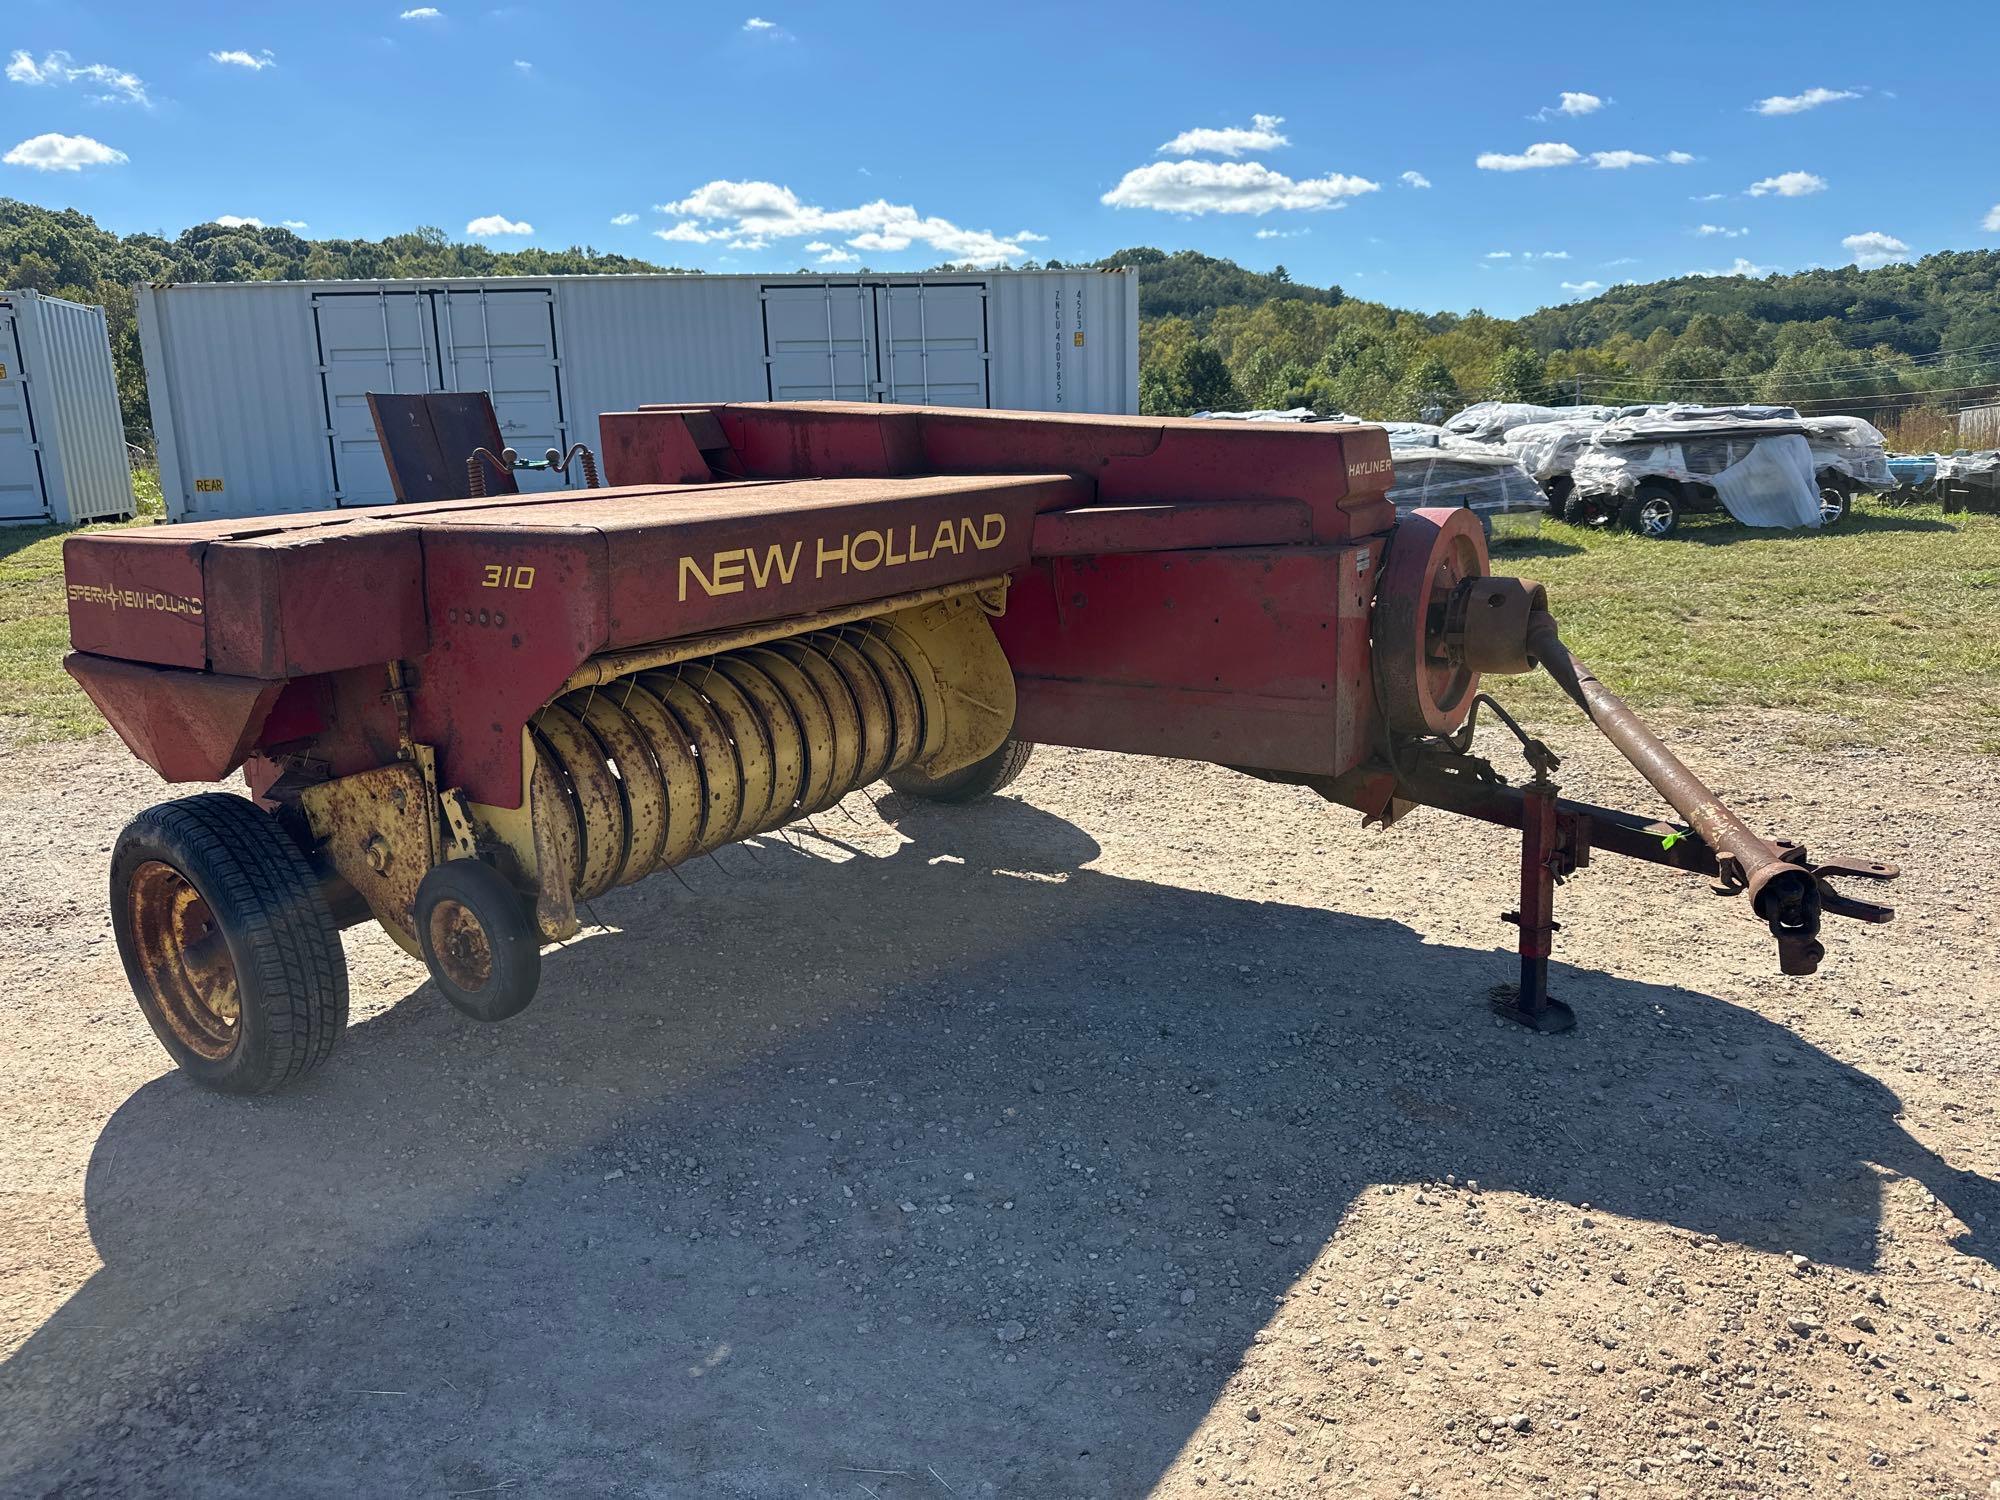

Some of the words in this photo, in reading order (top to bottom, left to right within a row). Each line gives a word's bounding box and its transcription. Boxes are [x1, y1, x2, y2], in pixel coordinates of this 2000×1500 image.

[1348, 459, 1392, 477] HAYLINER
[196, 479, 224, 492] REAR
[678, 541, 802, 602] NEW
[815, 513, 1006, 579] HOLLAND
[482, 565, 536, 589] 310
[68, 584, 107, 604] SPERRY
[118, 590, 145, 609] NEW
[146, 593, 203, 616] HOLLAND
